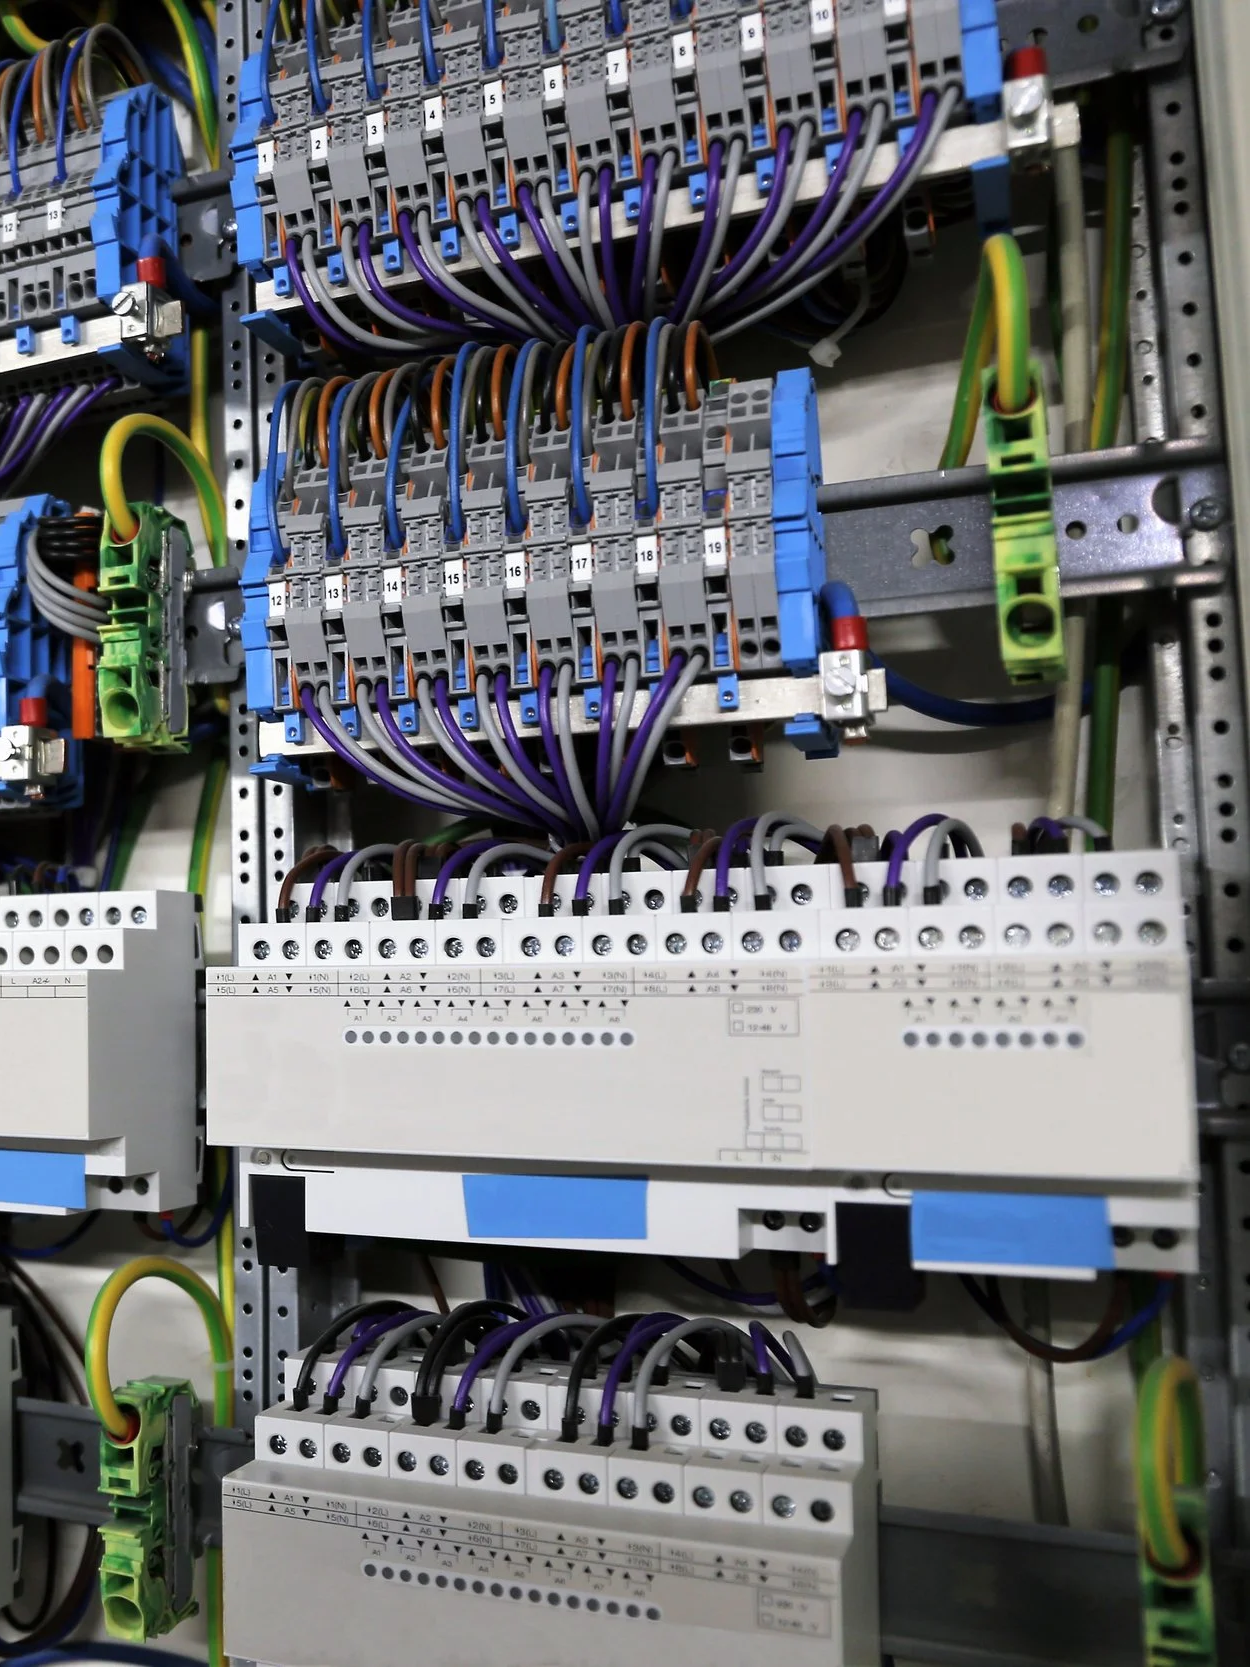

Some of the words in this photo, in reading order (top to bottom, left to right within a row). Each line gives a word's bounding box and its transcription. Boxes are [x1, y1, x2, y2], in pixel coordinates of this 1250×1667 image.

[815, 10, 829, 21] 10
[748, 28, 755, 39] 9
[679, 46, 686, 56] 8
[613, 63, 619, 73] 7
[549, 79, 556, 89] 6
[489, 94, 496, 105] 5
[429, 110, 436, 120] 4
[371, 125, 377, 135] 3
[315, 139, 321, 150] 2
[262, 154, 267, 163] 1
[49, 211, 59, 220] 13
[4, 223, 14, 232] 12
[708, 542, 722, 554] 19
[640, 550, 654, 562] 18
[575, 558, 588, 569] 17
[509, 566, 521, 577] 16
[447, 573, 460, 585] 15
[386, 581, 398, 592] 14
[327, 588, 339, 599] 13
[271, 595, 282, 606] 12
[11, 977, 16, 985] L
[32, 977, 42, 985] A2
[221, 974, 235, 982] 1(L)
[267, 973, 277, 981] A1
[313, 973, 329, 982] 1(N)
[353, 973, 370, 982] 2(L)
[399, 973, 412, 981] A2
[451, 973, 470, 981] 2(N)
[551, 972, 565, 980] A3
[221, 986, 236, 994] 5(L)
[267, 986, 279, 994] A5
[313, 986, 331, 994] 5(N)
[353, 986, 370, 994] 6(L)
[399, 986, 412, 994] A6
[452, 986, 471, 994] 6(N)
[237, 1487, 251, 1497] 1(L)
[284, 1494, 294, 1502] A1
[330, 1501, 348, 1511] 1(N)
[372, 1507, 389, 1517] 2(L)
[419, 1513, 431, 1522] A2
[472, 1521, 492, 1532] 2(N)
[575, 1536, 589, 1545] A3
[237, 1500, 252, 1509] 5(L)
[284, 1507, 296, 1515] A5
[330, 1513, 349, 1524] 5(N)
[372, 1520, 389, 1530] 6(L)
[419, 1526, 432, 1535] A6
[472, 1535, 493, 1545] 6(N)
[575, 1549, 588, 1559] A7
[372, 1549, 381, 1557] A1
[406, 1554, 416, 1562] A2
